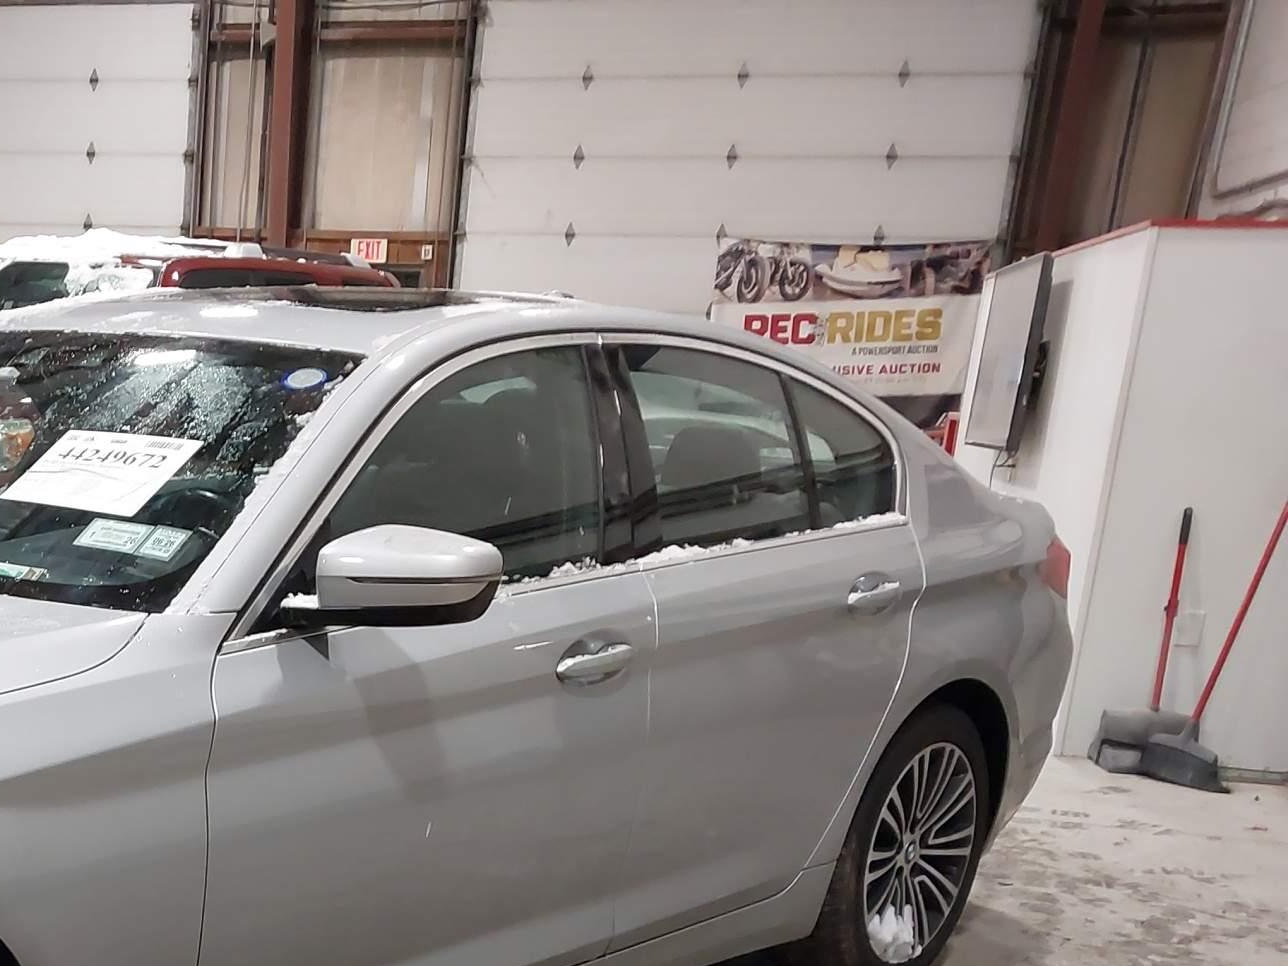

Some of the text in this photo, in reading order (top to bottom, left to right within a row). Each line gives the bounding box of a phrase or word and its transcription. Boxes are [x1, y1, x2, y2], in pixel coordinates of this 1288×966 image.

[357, 240, 381, 260] EXIT
[827, 308, 943, 344] RIDES
[851, 344, 938, 356] A POWERSPORT AUCTION
[879, 363, 941, 374] AUCTION
[58, 447, 168, 468] 44249672
